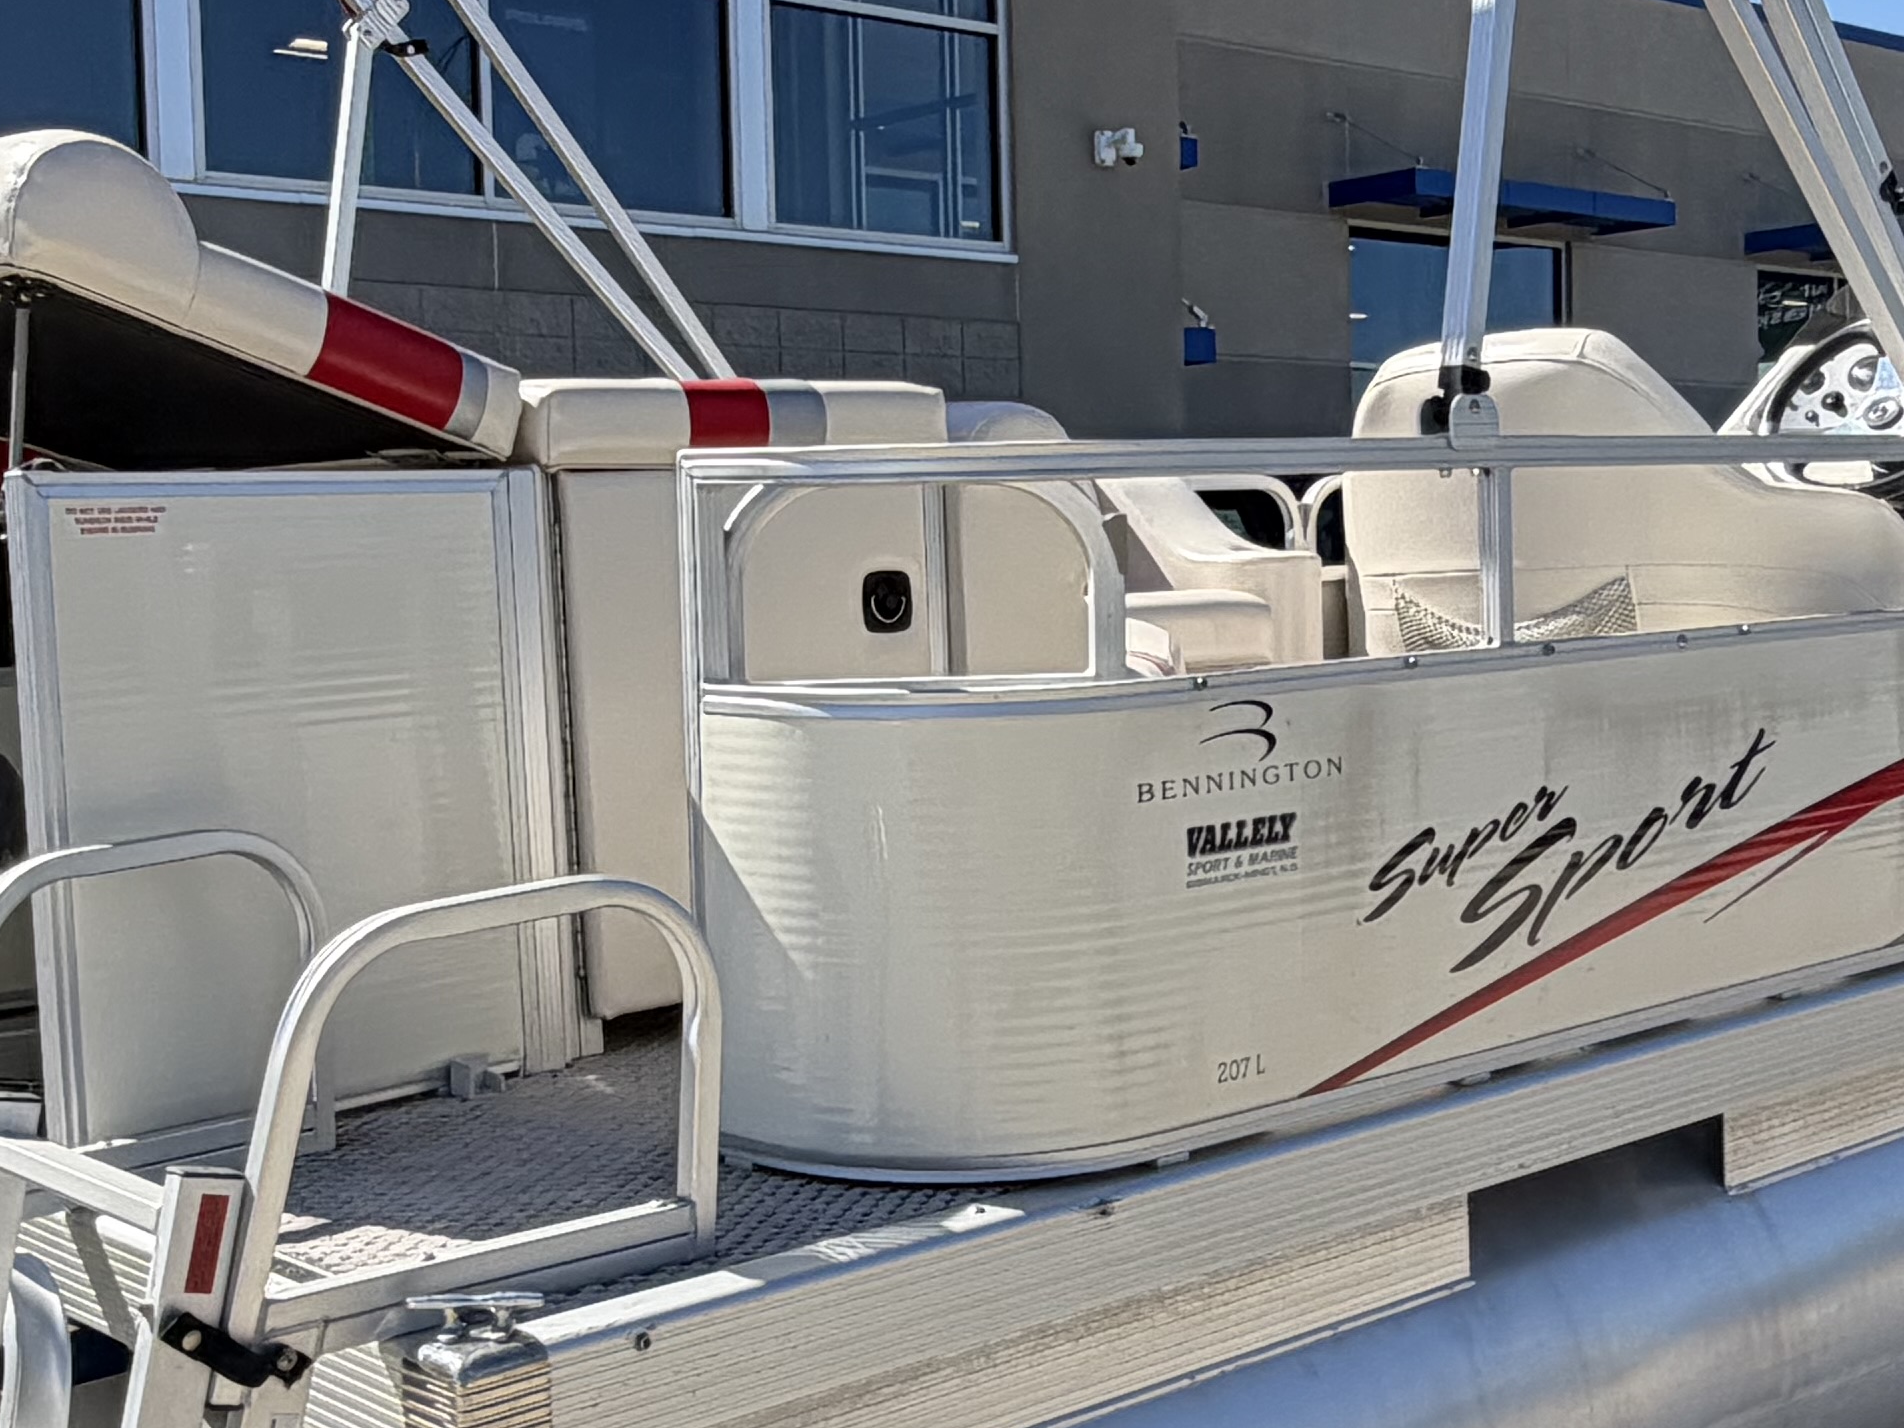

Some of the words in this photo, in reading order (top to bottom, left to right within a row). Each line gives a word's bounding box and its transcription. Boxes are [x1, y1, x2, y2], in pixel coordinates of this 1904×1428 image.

[1137, 756, 1343, 803] BENNINGTON
[1186, 811, 1297, 858] VALLELY
[1362, 785, 1569, 923] Super
[1448, 728, 1777, 974] Sport
[1187, 856, 1231, 877] SPORT
[1247, 845, 1298, 866] MARINE
[1217, 1056, 1251, 1084] 207
[1256, 1053, 1266, 1075] L
